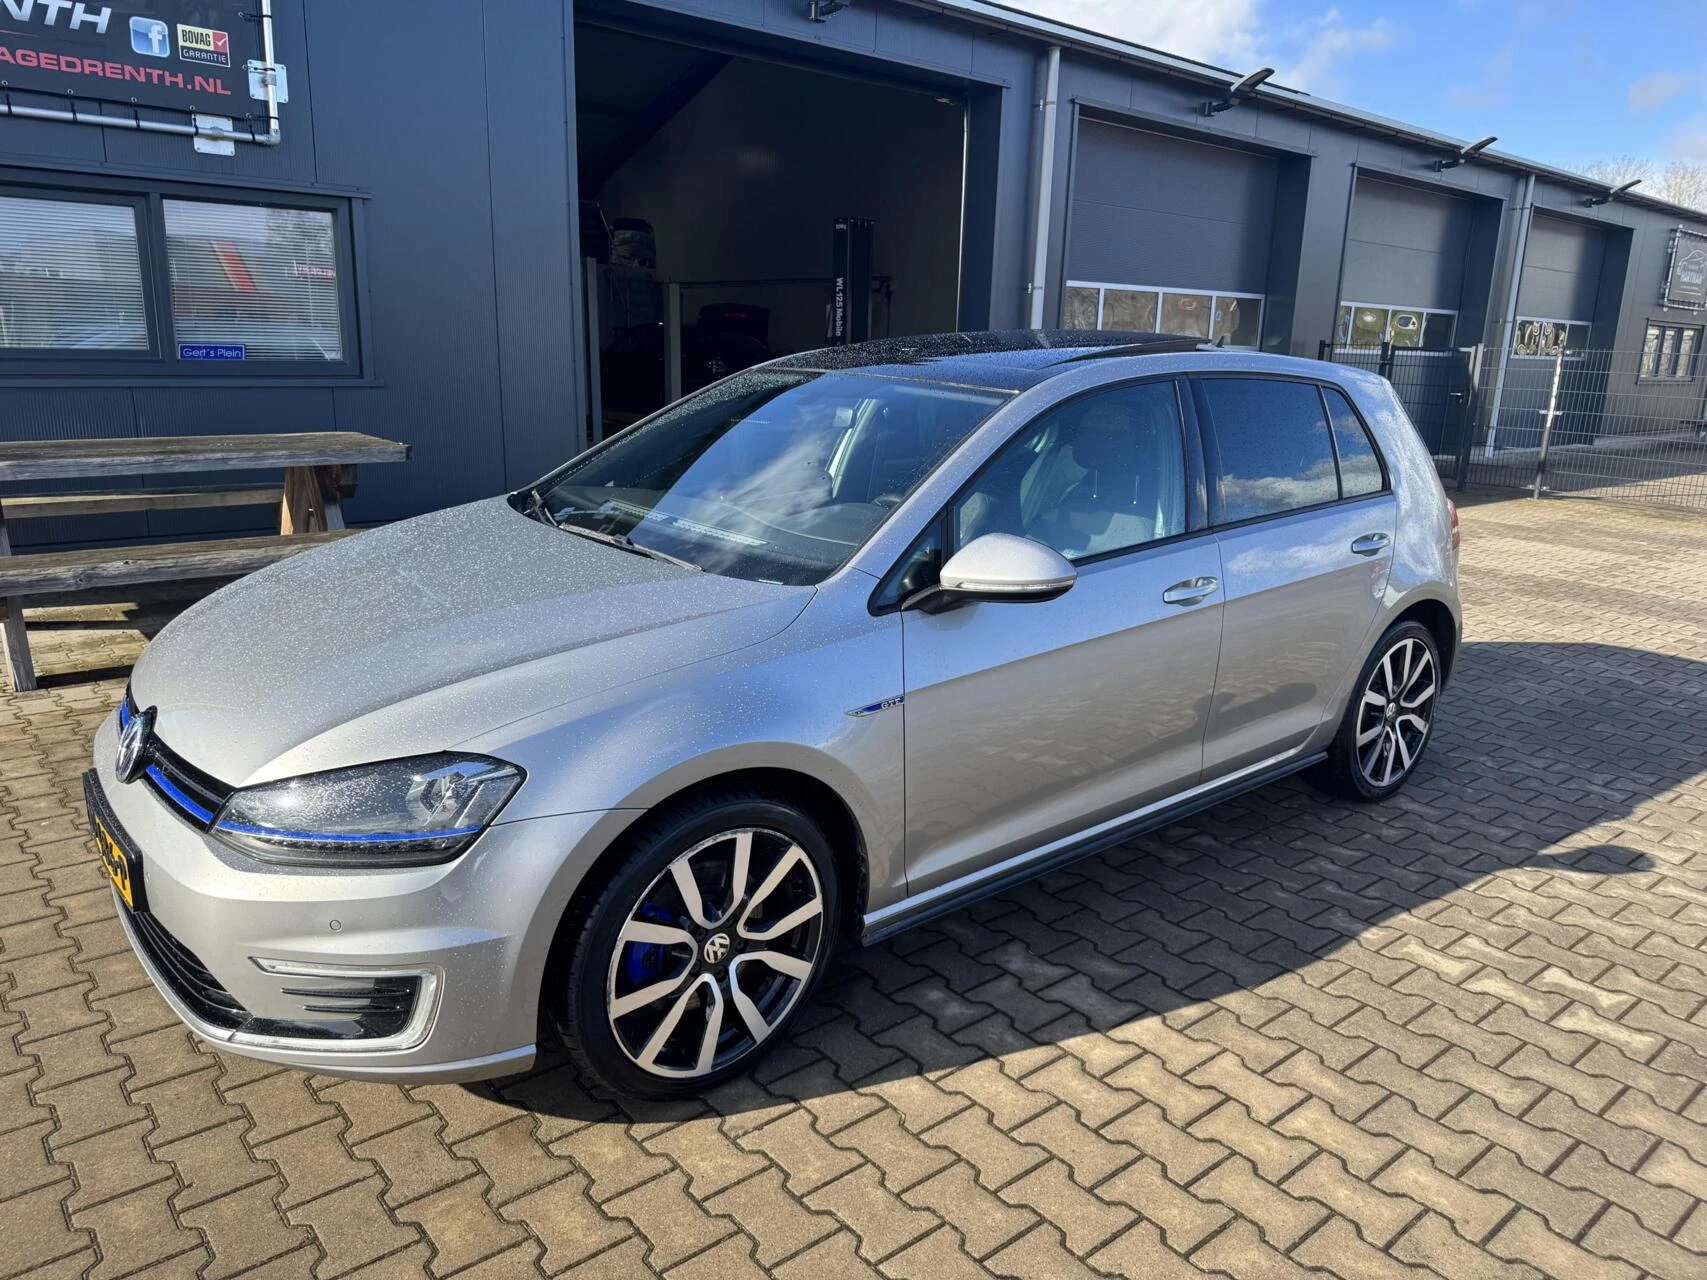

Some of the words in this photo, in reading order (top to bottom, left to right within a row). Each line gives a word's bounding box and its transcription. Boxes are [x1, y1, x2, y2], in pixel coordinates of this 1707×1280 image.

[181, 29, 211, 47] BOVAG
[183, 49, 227, 63] GARANTIE
[0, 46, 231, 96] AGEDRENTH.NL
[835, 308, 843, 337] Mobile
[217, 348, 241, 358] Plein
